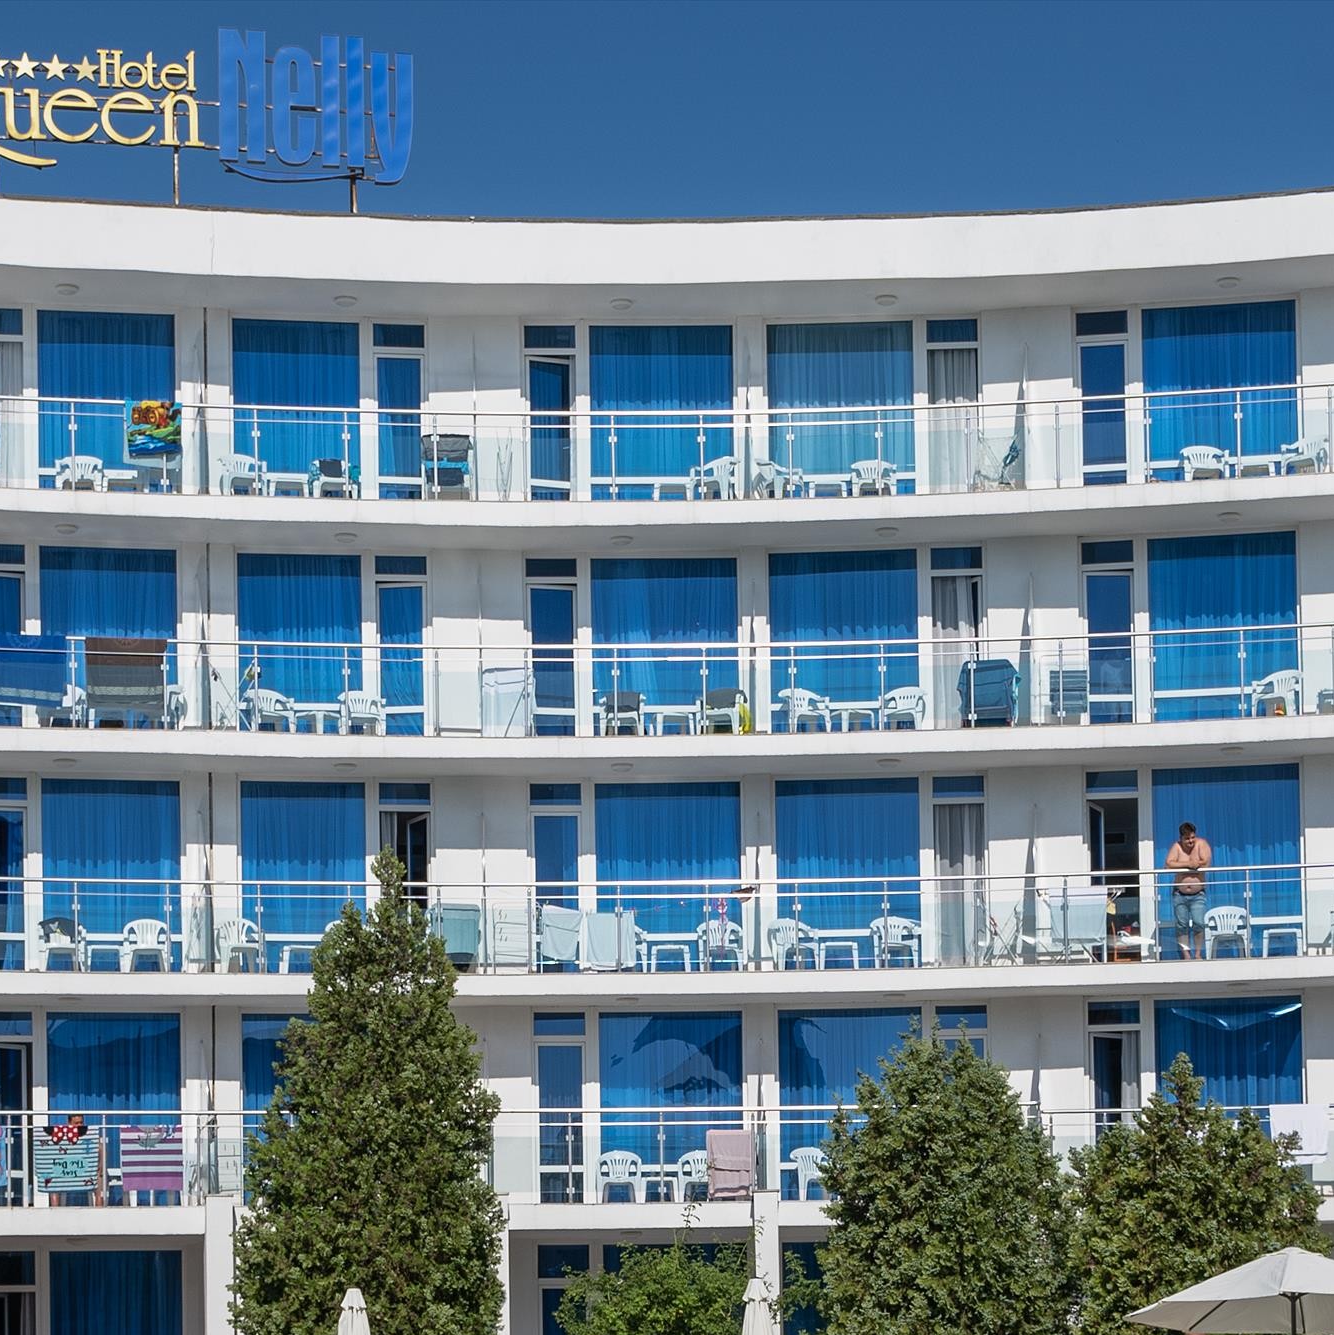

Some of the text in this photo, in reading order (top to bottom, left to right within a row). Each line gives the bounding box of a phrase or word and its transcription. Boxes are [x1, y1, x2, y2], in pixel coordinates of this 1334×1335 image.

[97, 49, 197, 91] Hotel
[218, 28, 414, 185] Nelly
[69, 1159, 84, 1169] The
